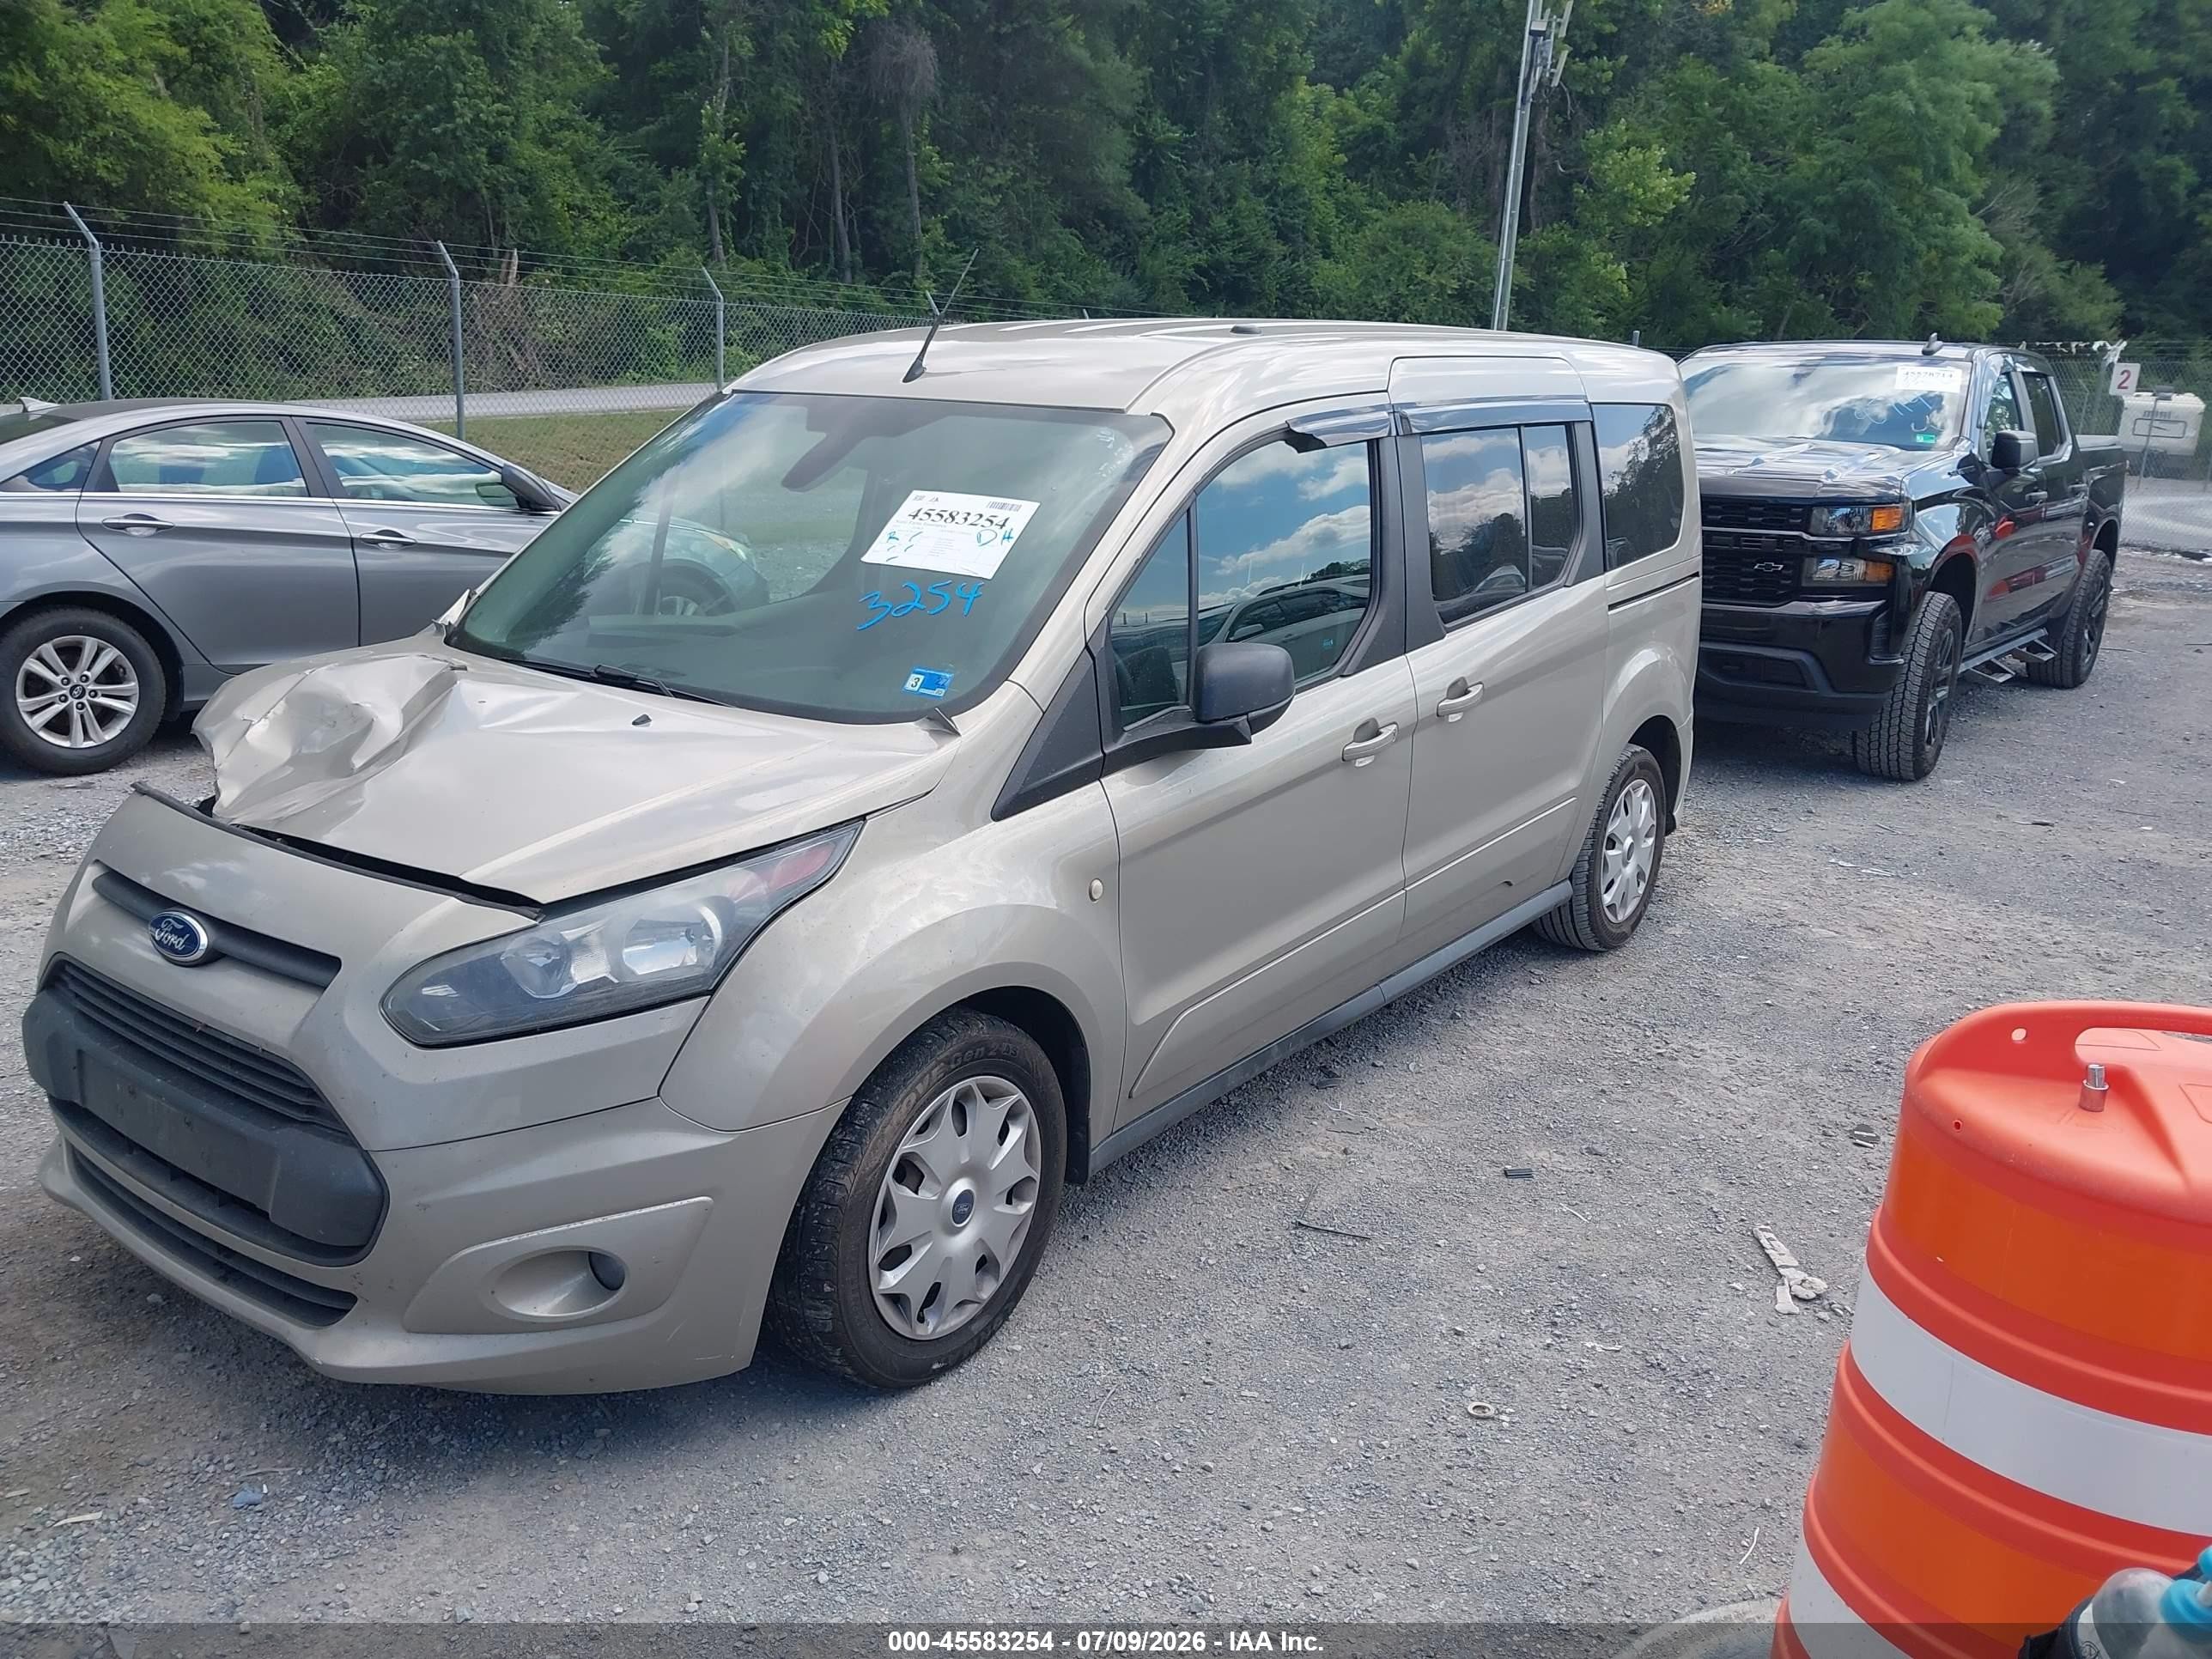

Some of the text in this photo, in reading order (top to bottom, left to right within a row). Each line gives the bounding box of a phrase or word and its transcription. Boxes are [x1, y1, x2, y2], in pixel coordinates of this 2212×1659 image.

[2117, 369, 2131, 390] 2
[908, 507, 1011, 530] 45583254
[856, 580, 985, 631] 3254
[910, 677, 921, 688] 3
[155, 918, 190, 951] Ford
